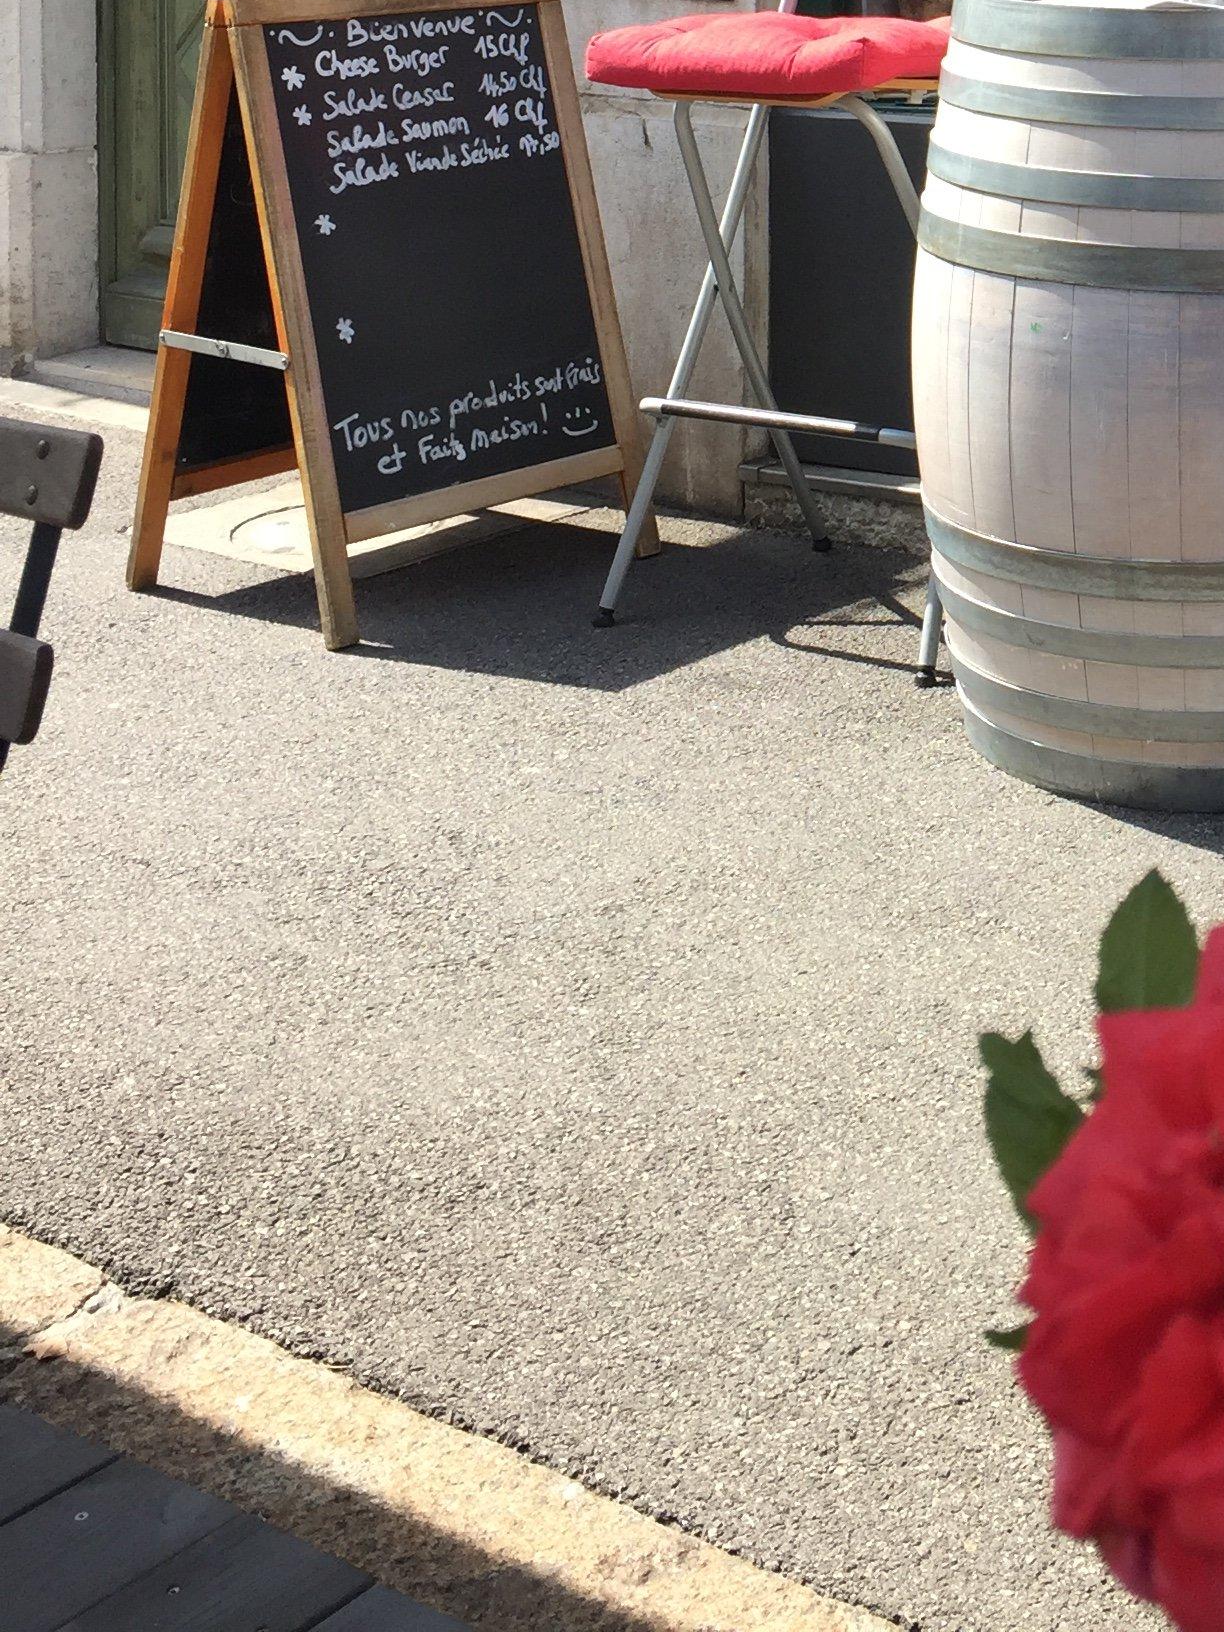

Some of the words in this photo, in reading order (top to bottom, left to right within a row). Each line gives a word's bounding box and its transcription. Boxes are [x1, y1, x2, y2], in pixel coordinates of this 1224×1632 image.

[314, 48, 380, 80] Cheese
[383, 44, 450, 77] Burger
[322, 87, 389, 121] Salade
[326, 120, 400, 159] Salade
[328, 152, 400, 196] Salade
[332, 412, 396, 452] Tous
[400, 405, 442, 431] nos
[448, 371, 533, 430] produits
[376, 442, 408, 475] et
